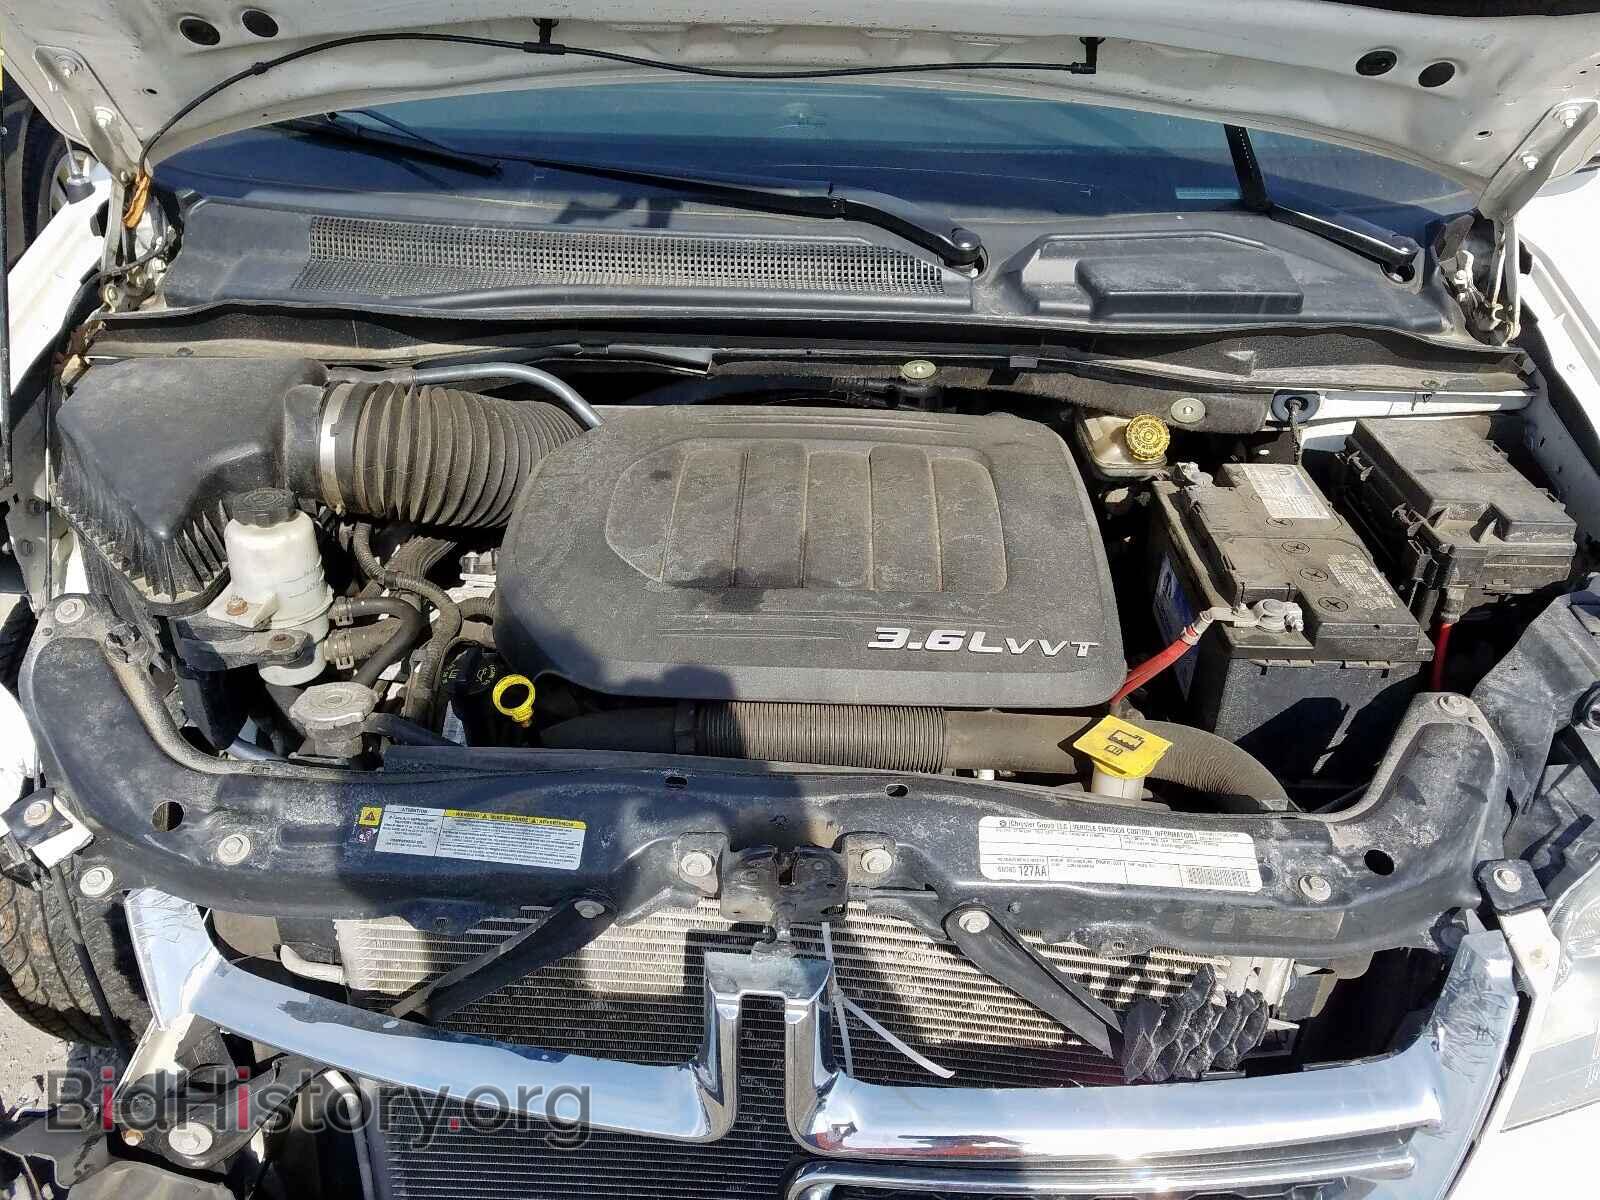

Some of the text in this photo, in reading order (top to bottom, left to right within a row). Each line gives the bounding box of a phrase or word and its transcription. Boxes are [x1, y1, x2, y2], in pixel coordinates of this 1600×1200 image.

[1009, 819, 1036, 830] Chrysler
[1036, 821, 1055, 831] Group
[1072, 823, 1097, 833] VEHICLE
[1097, 825, 1126, 834] EMISSION
[1126, 828, 1152, 837] CONTROL
[1154, 830, 1194, 839] INFORMATION
[1019, 865, 1048, 878] 127AA
